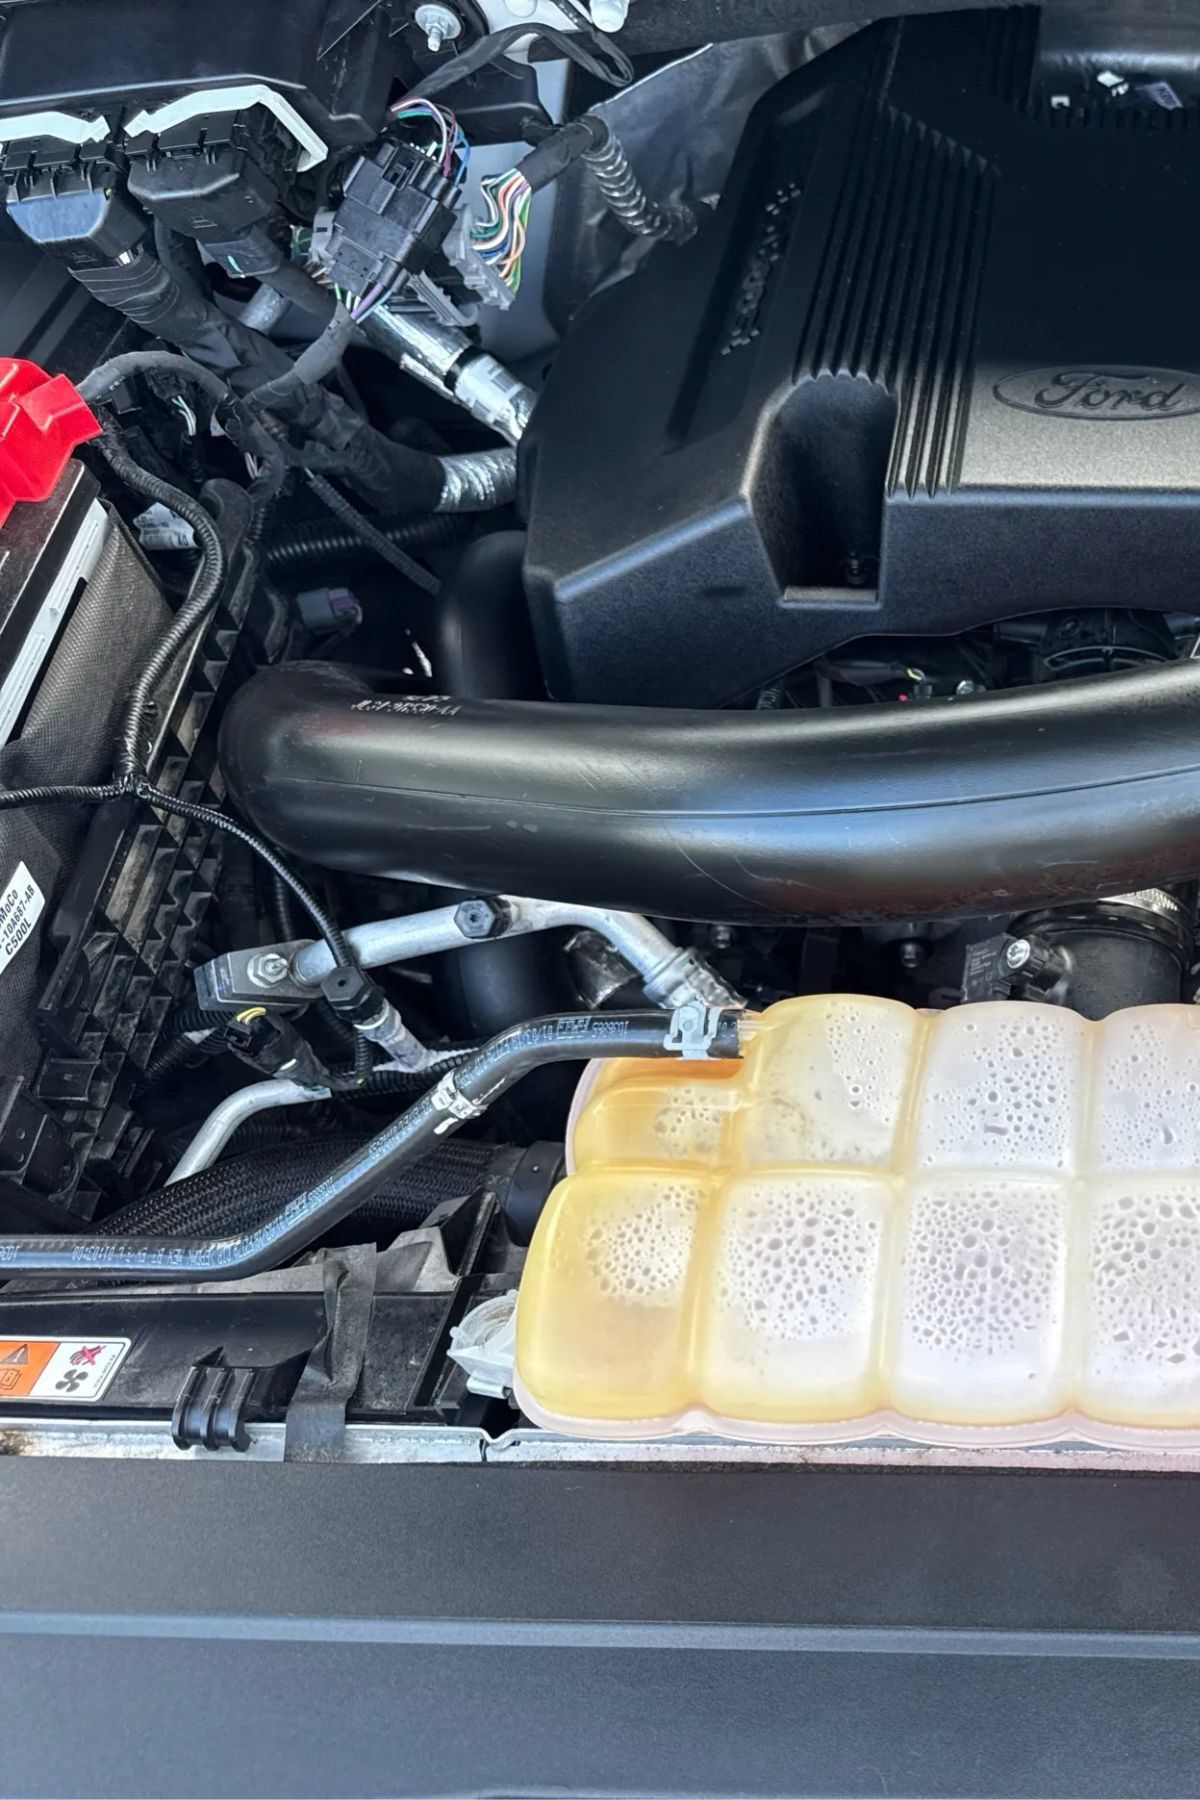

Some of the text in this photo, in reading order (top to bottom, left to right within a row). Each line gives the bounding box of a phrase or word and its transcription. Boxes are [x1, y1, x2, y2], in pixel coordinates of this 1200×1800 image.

[1034, 371, 1187, 411] Ford
[0, 884, 36, 949] -10A687-AB
[5, 918, 32, 956] C500L
